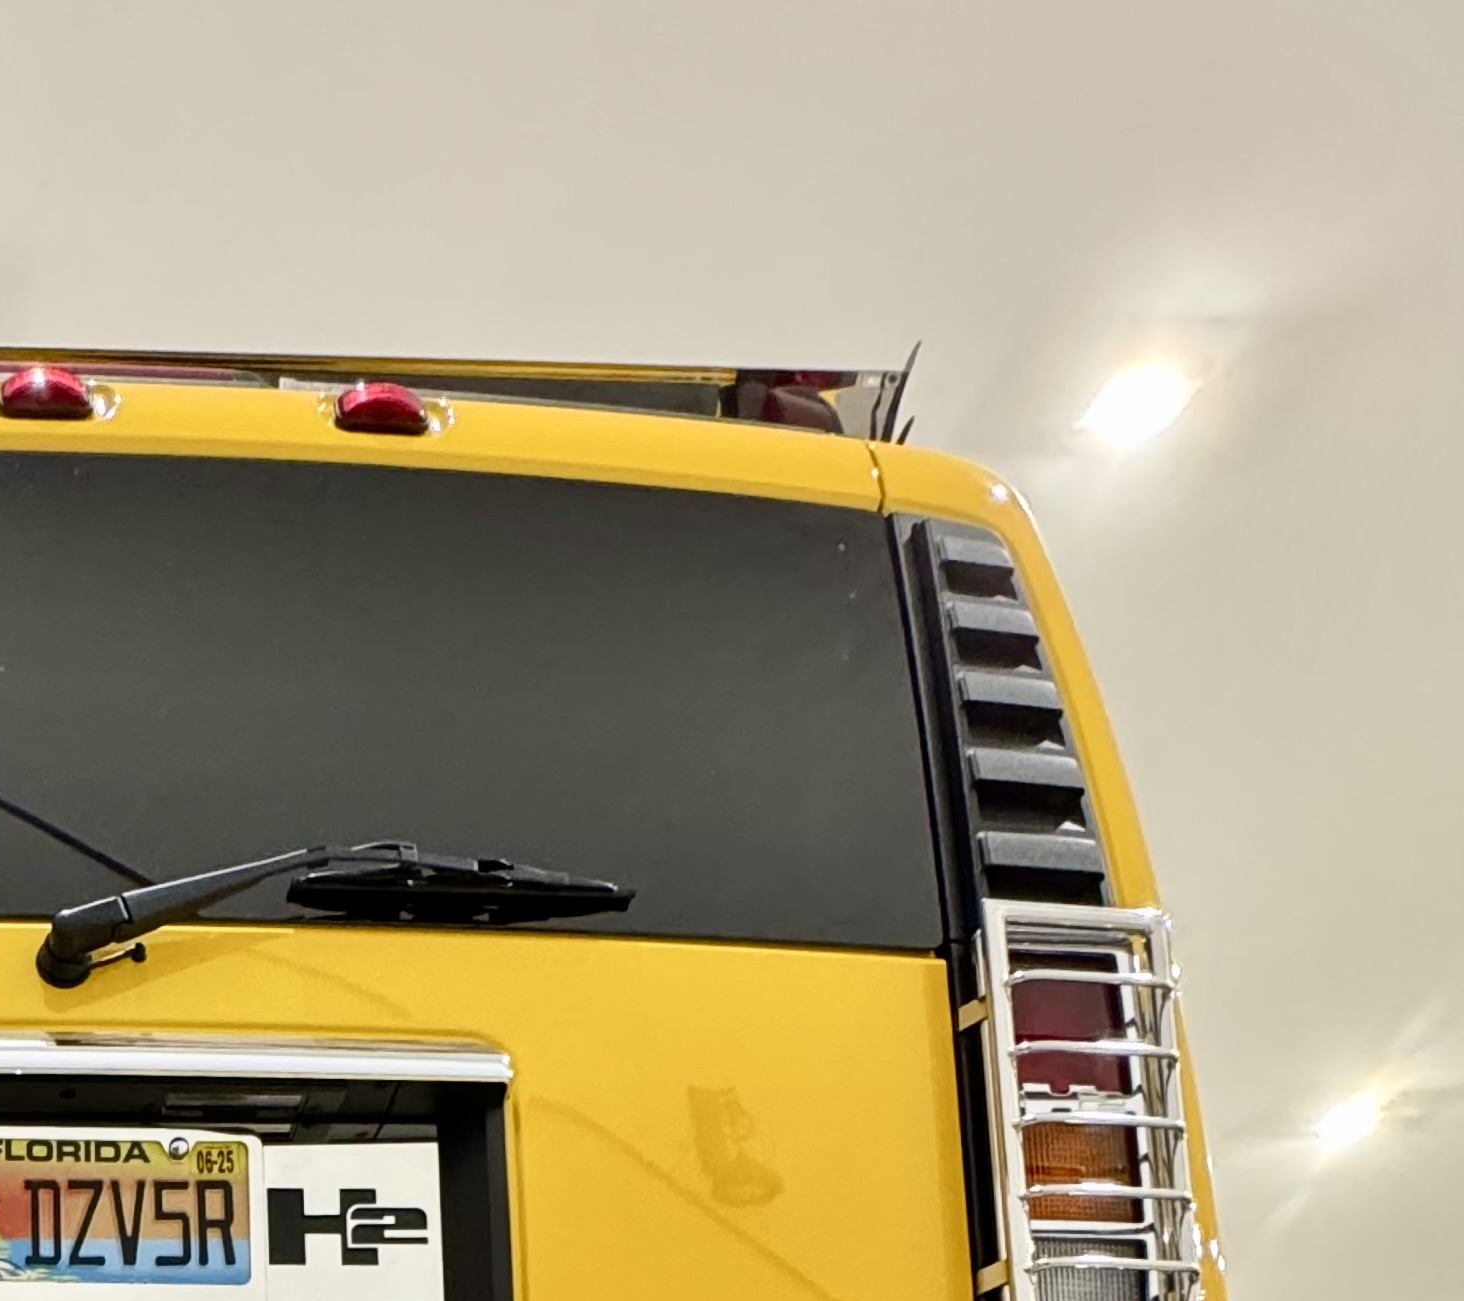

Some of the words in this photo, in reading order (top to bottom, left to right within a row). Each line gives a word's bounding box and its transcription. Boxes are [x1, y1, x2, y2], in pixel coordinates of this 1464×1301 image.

[196, 1149, 234, 1174] 06-25
[24, 1180, 236, 1266] DZV5R
[267, 1188, 429, 1266] H2
